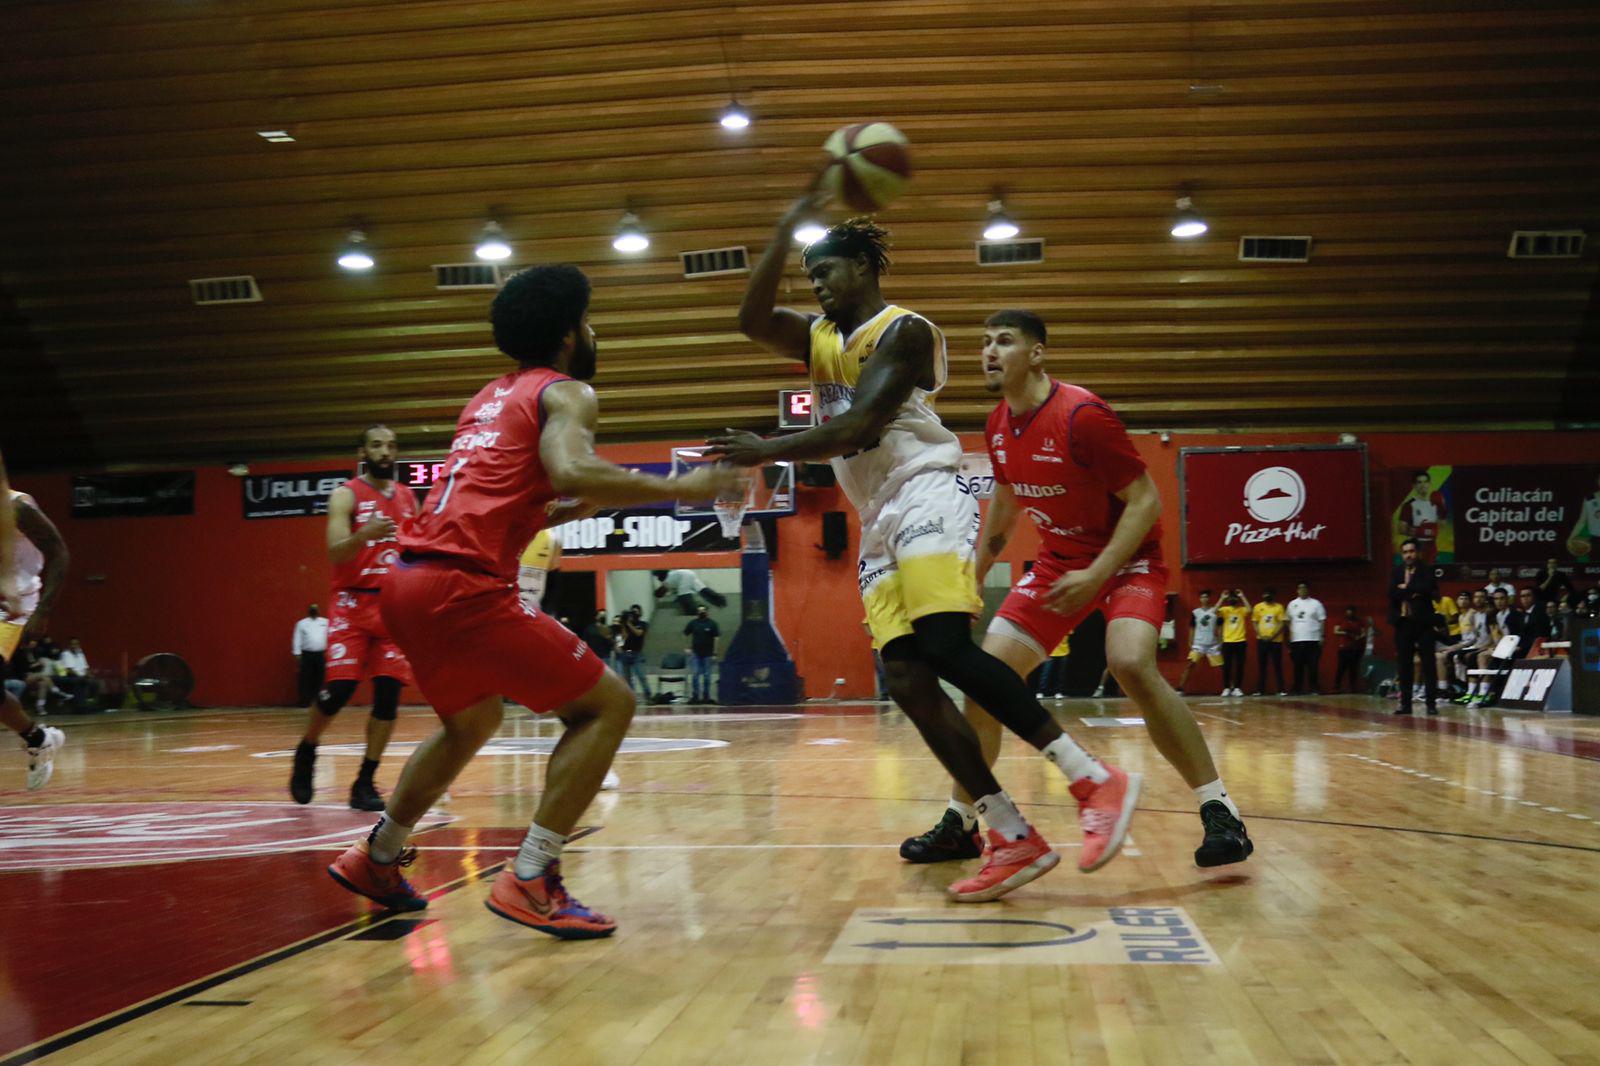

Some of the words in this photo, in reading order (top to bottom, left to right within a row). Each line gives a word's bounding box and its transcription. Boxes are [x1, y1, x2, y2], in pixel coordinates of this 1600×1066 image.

[791, 394, 811, 415] 2
[1475, 487, 1553, 503] Culiacán
[1465, 507, 1530, 526] Capital
[1534, 506, 1565, 522] del
[1224, 522, 1282, 546] Pizza
[1282, 521, 1328, 543] Hut
[1479, 527, 1557, 546] Deporte
[1107, 906, 1211, 963] RULER
